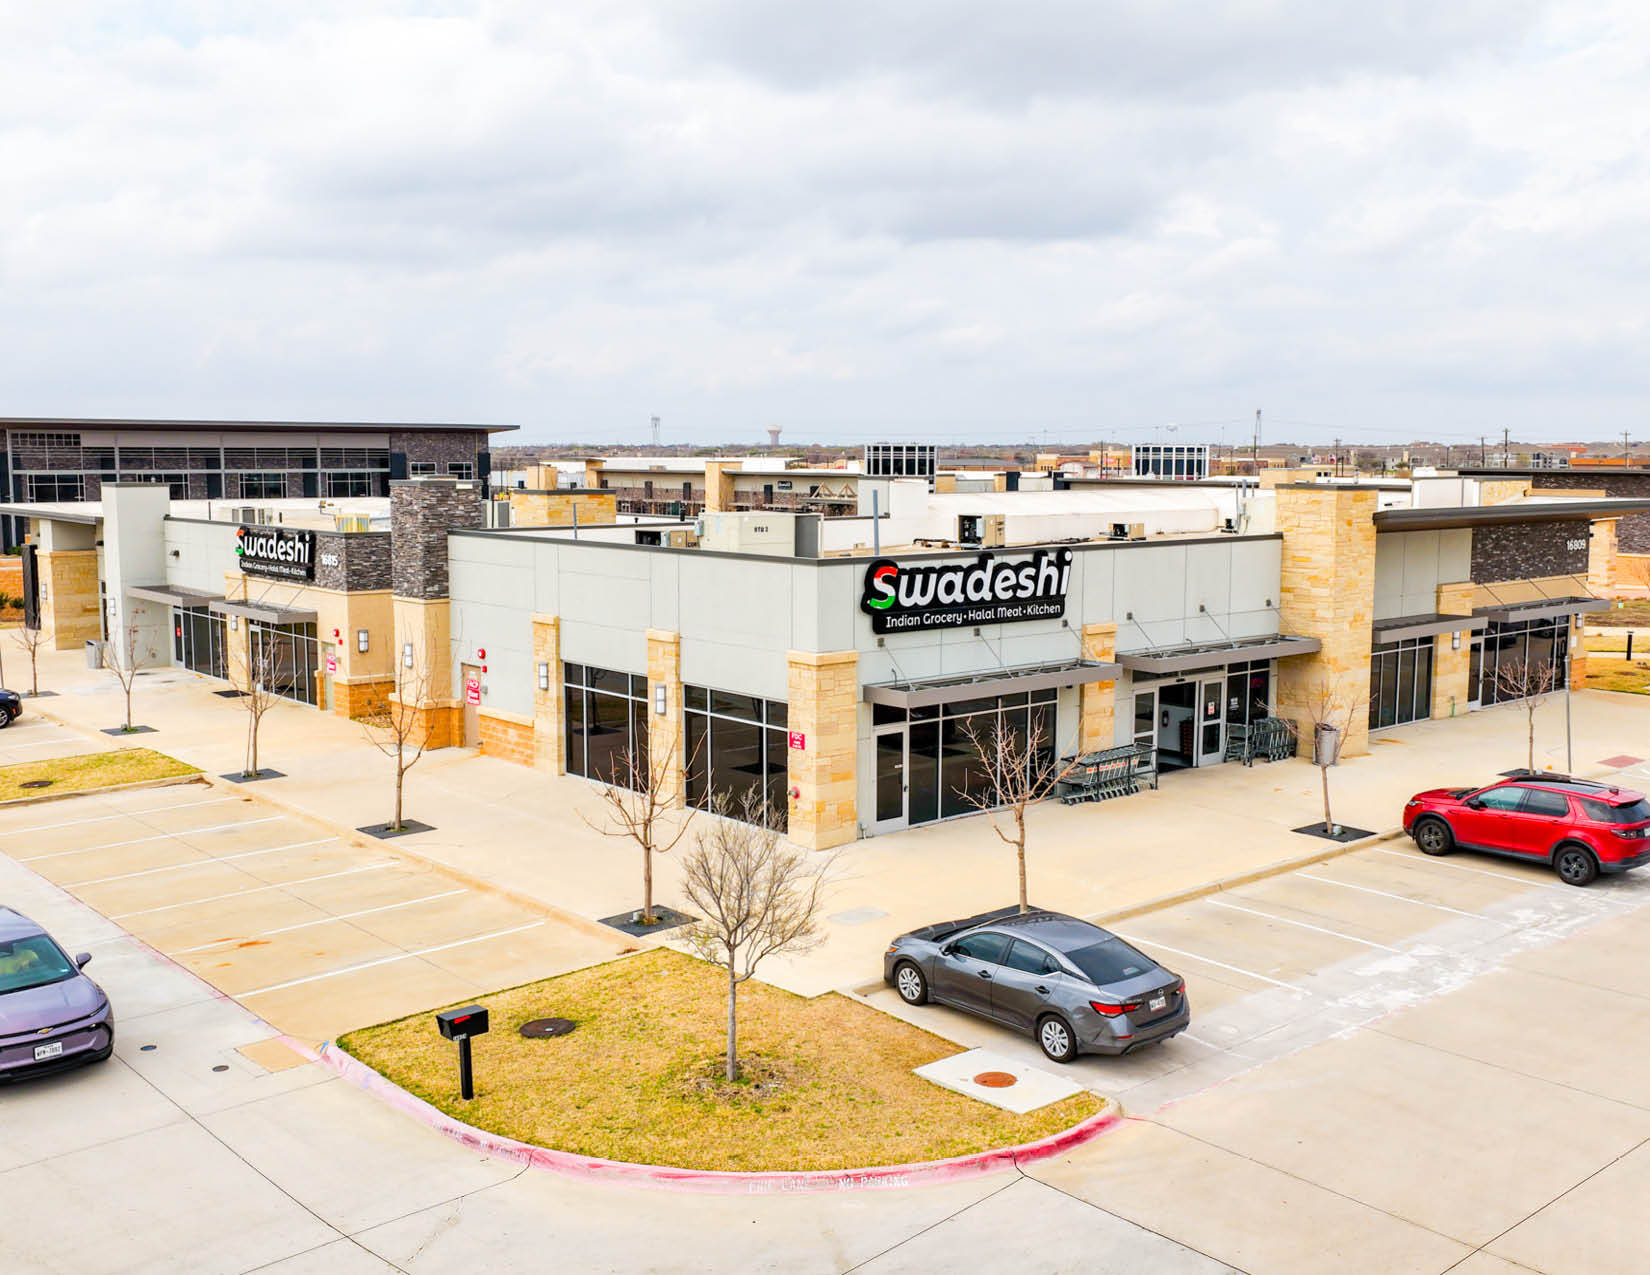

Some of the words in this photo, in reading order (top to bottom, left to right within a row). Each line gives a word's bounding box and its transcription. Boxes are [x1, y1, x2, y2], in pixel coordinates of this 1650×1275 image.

[235, 529, 310, 564] Swadeshi
[1567, 539, 1585, 551] 16809
[868, 550, 1073, 610] Swadeshi
[886, 615, 921, 628] Indian
[923, 612, 963, 625] Grocery
[968, 609, 995, 621] Halal
[997, 605, 1023, 618] Meat
[1027, 603, 1061, 616] Kitchen
